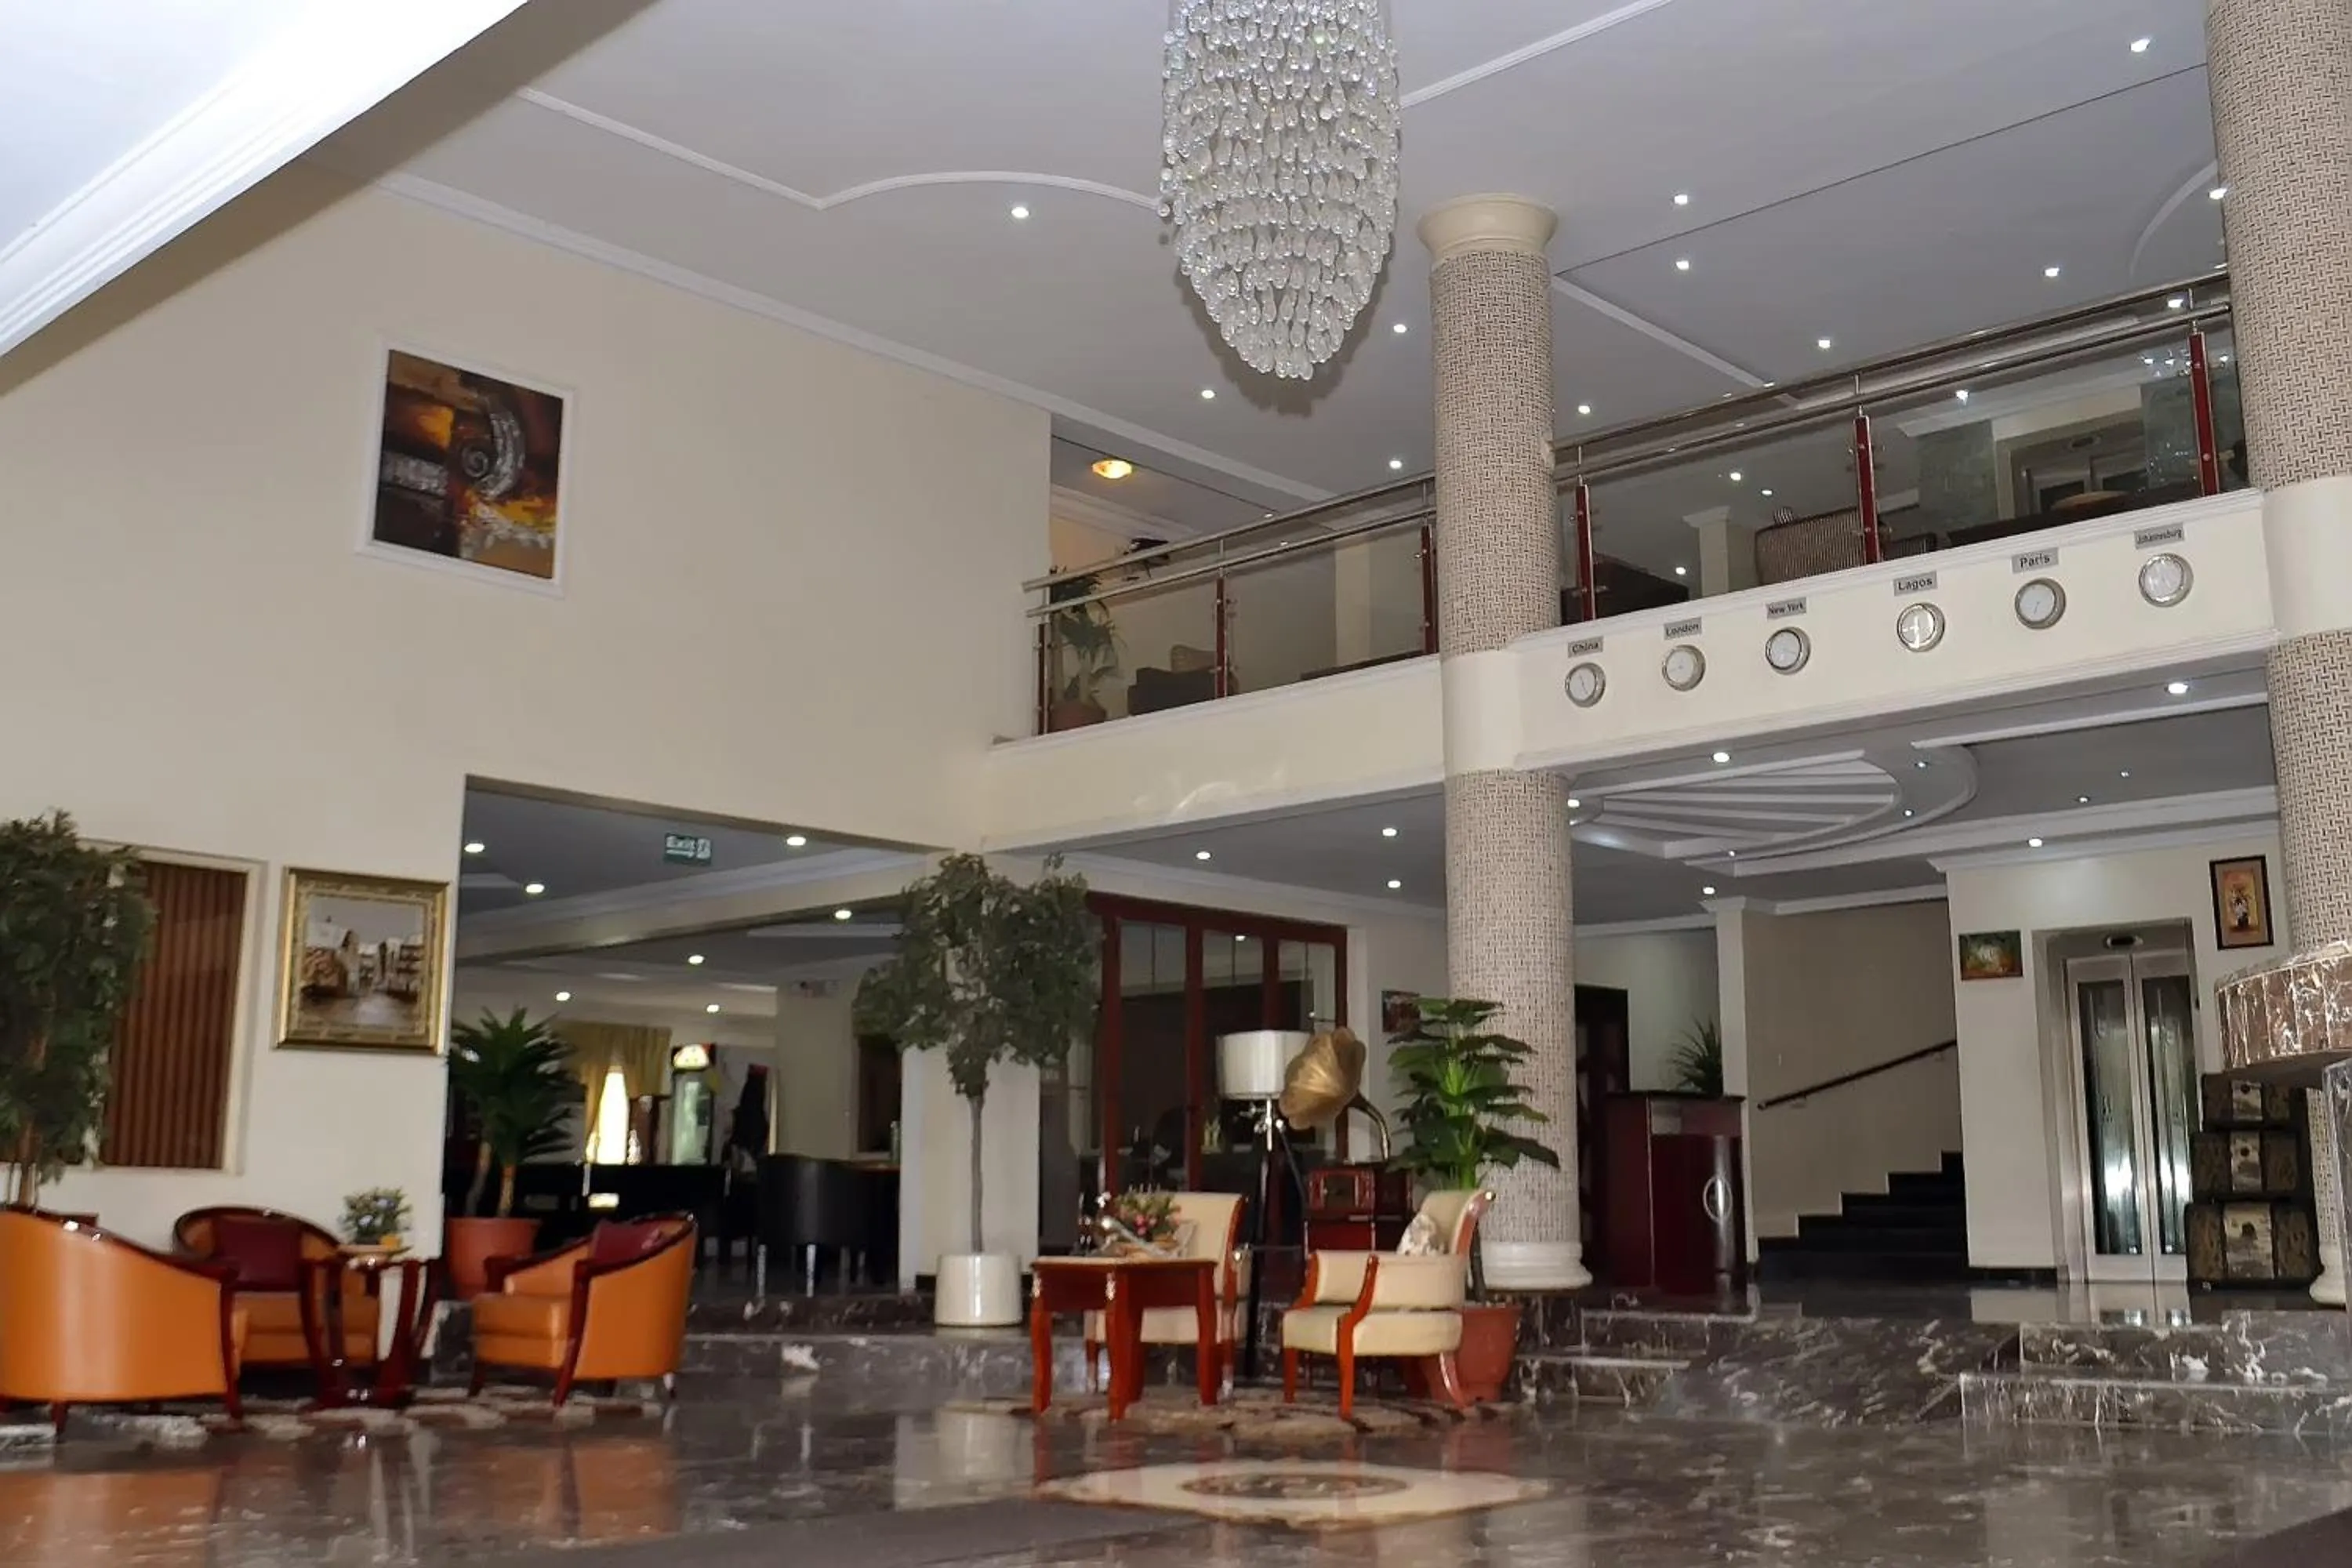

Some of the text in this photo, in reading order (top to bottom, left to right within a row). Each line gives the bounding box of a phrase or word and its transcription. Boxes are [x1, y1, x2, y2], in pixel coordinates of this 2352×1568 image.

[2020, 553, 2050, 568] Paris
[1898, 578, 1933, 591] Lagos
[1666, 623, 1700, 636] London
[1572, 642, 1599, 654] China
[666, 836, 695, 850] Exit
